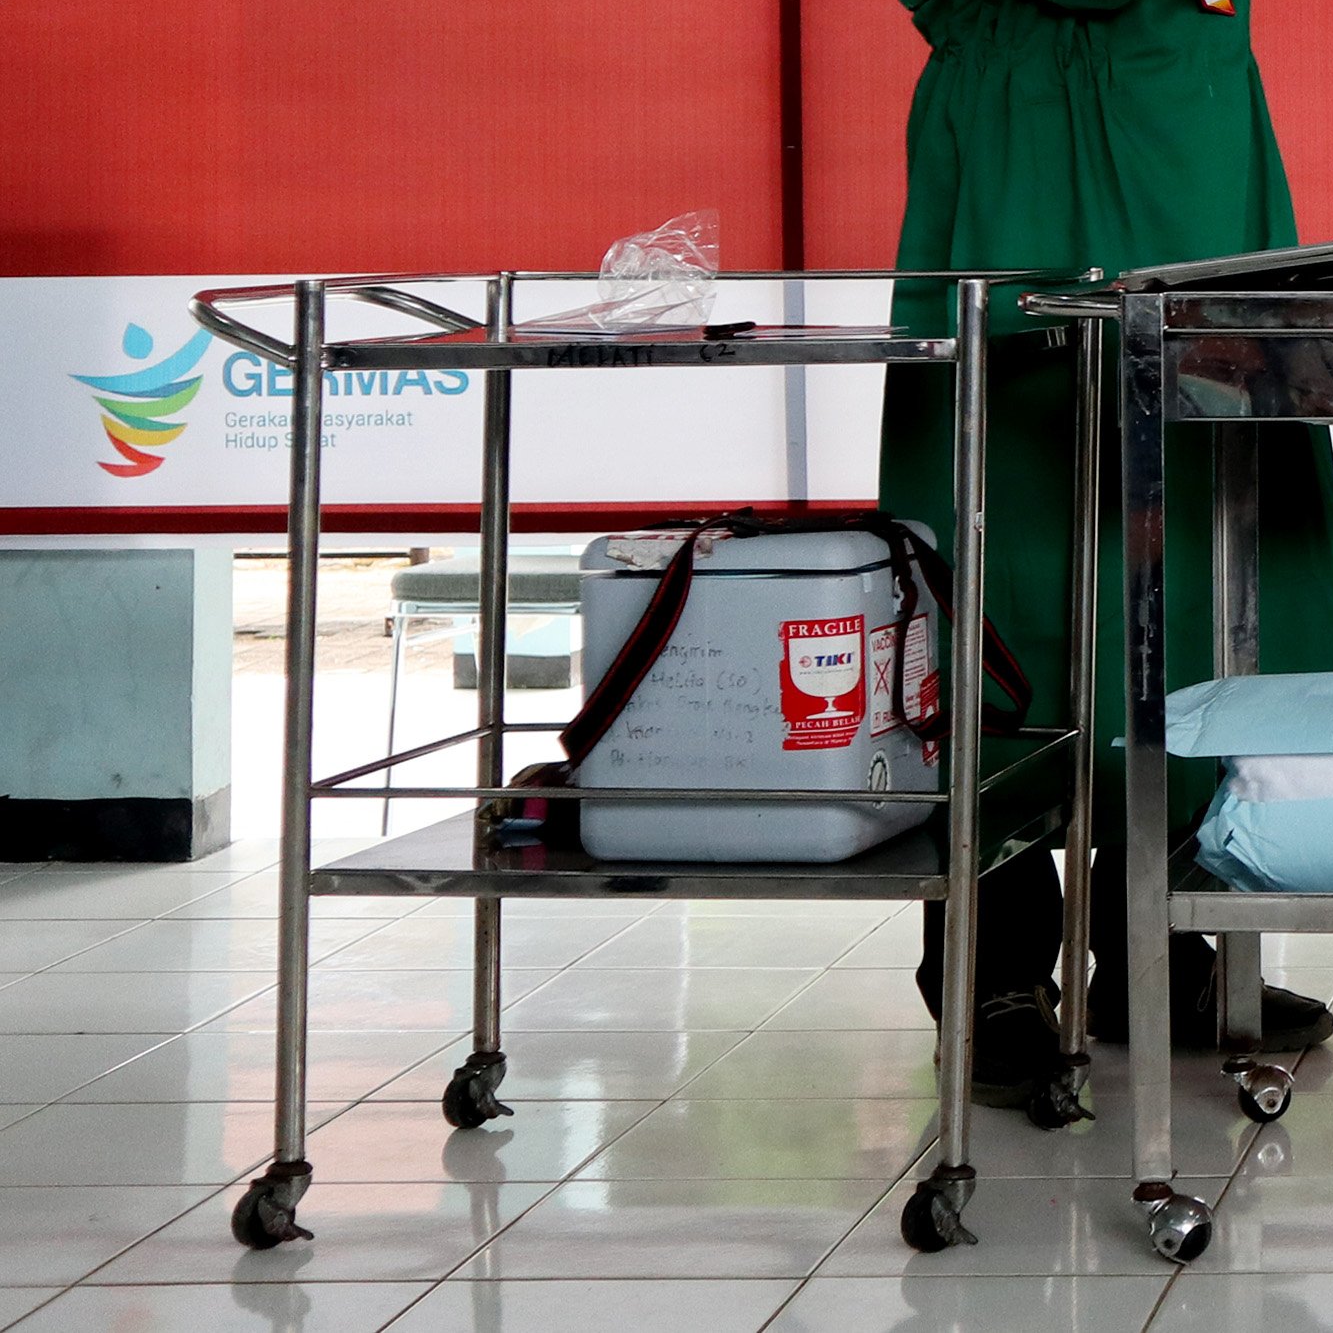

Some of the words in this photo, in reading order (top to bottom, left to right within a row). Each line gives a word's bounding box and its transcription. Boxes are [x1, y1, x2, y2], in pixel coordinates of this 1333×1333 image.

[224, 411, 290, 429] Geraka
[322, 409, 414, 431] asyarakat
[224, 432, 279, 452] Hidup
[284, 431, 337, 450] Sat
[788, 618, 862, 637] FRAGILE
[814, 652, 853, 667] TIKI
[795, 720, 830, 729] PECAH
